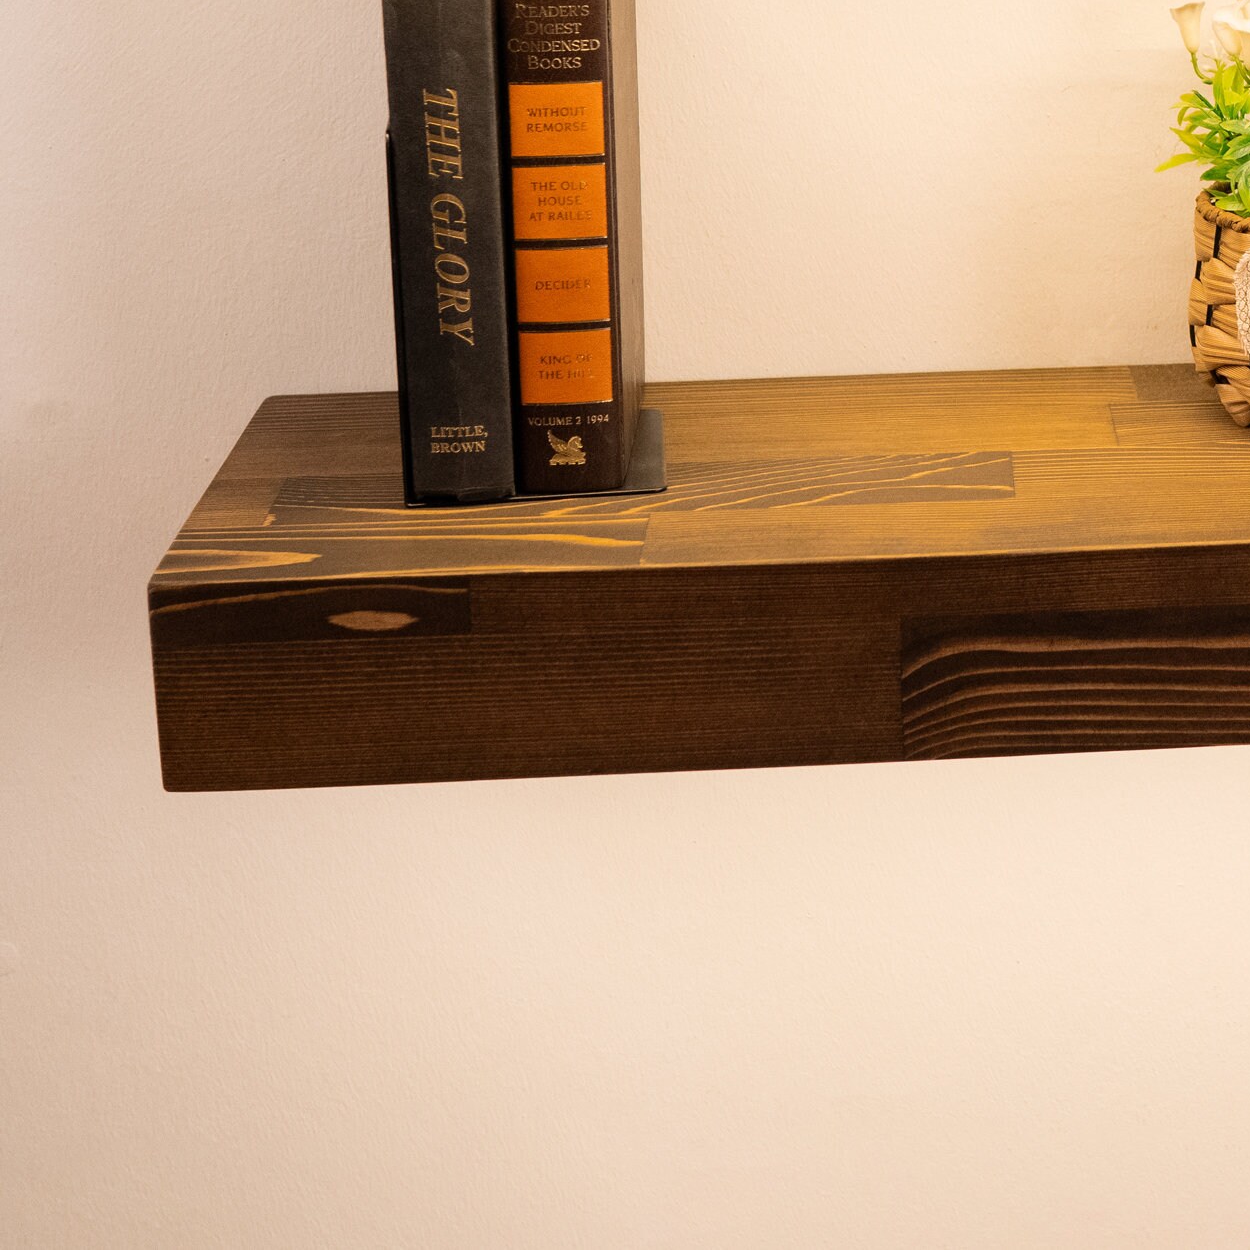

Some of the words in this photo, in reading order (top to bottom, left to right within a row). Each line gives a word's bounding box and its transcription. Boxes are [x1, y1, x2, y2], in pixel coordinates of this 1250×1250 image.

[515, 2, 590, 19] READER'S
[525, 21, 582, 35] DIGEST
[507, 38, 601, 53] CONDENSED
[527, 54, 582, 70] BOOKS
[526, 106, 586, 118] WITHOUT
[526, 121, 588, 133] REMORSE
[423, 88, 464, 180] THE
[530, 181, 557, 192] THE
[538, 196, 582, 207] HOUSE
[528, 212, 542, 222] AT
[430, 192, 475, 347] GLORY
[535, 279, 591, 291] DECIDER
[540, 354, 572, 365] KING
[538, 369, 564, 380] THE
[528, 416, 573, 427] VOLUME
[575, 416, 581, 425] 2
[586, 414, 610, 425] 1994
[431, 440, 486, 453] BROWN
